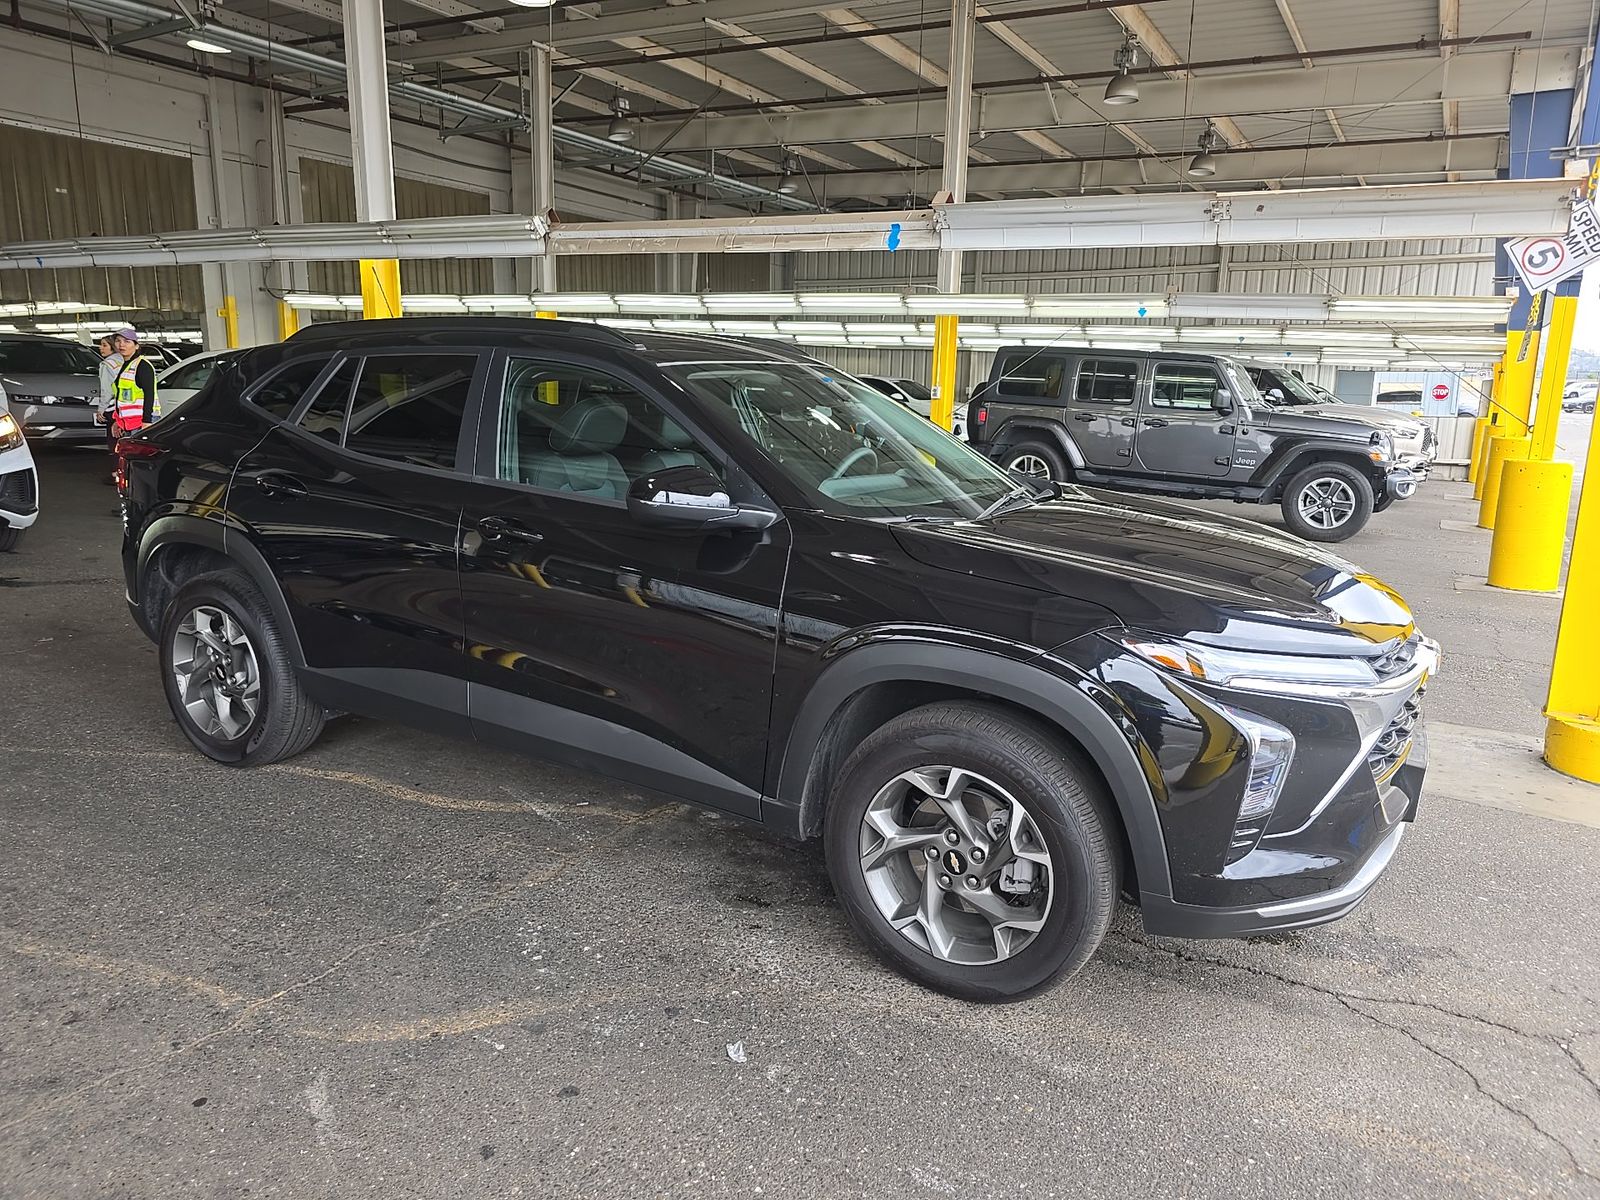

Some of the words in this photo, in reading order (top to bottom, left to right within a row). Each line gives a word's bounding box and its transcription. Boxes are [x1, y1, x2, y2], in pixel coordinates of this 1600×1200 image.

[1573, 211, 1600, 253] SPEED
[1562, 229, 1588, 259] IMIT
[1527, 246, 1560, 268] 5
[1432, 388, 1450, 396] STOP
[1235, 456, 1256, 466] Jeep
